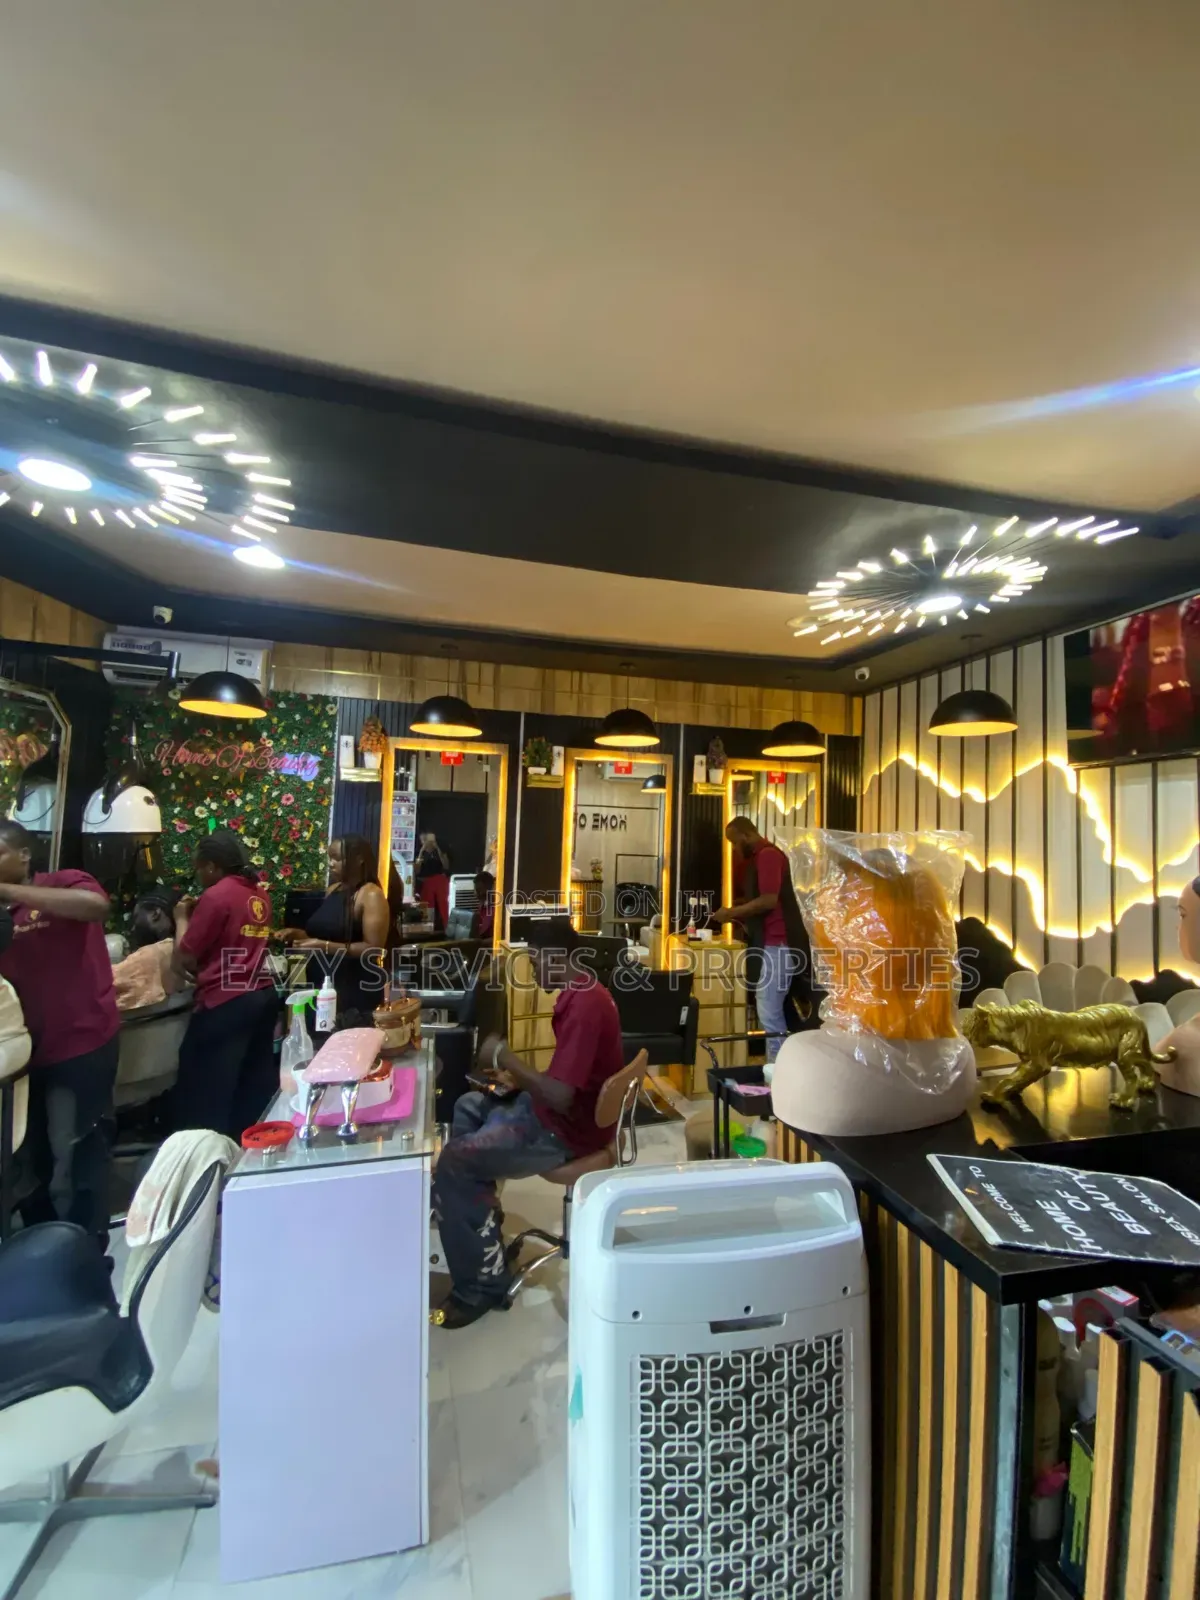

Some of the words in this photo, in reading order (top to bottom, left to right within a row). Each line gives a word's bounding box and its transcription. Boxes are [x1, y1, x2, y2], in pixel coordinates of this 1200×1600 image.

[216, 744, 244, 773] Of
[968, 1165, 986, 1179] TO
[980, 1182, 1034, 1233] WELCOME
[1055, 1189, 1091, 1212] OF
[1062, 1168, 1152, 1235] BEAUTY
[1112, 1177, 1166, 1214] SALON
[1035, 1199, 1103, 1251] HOME
